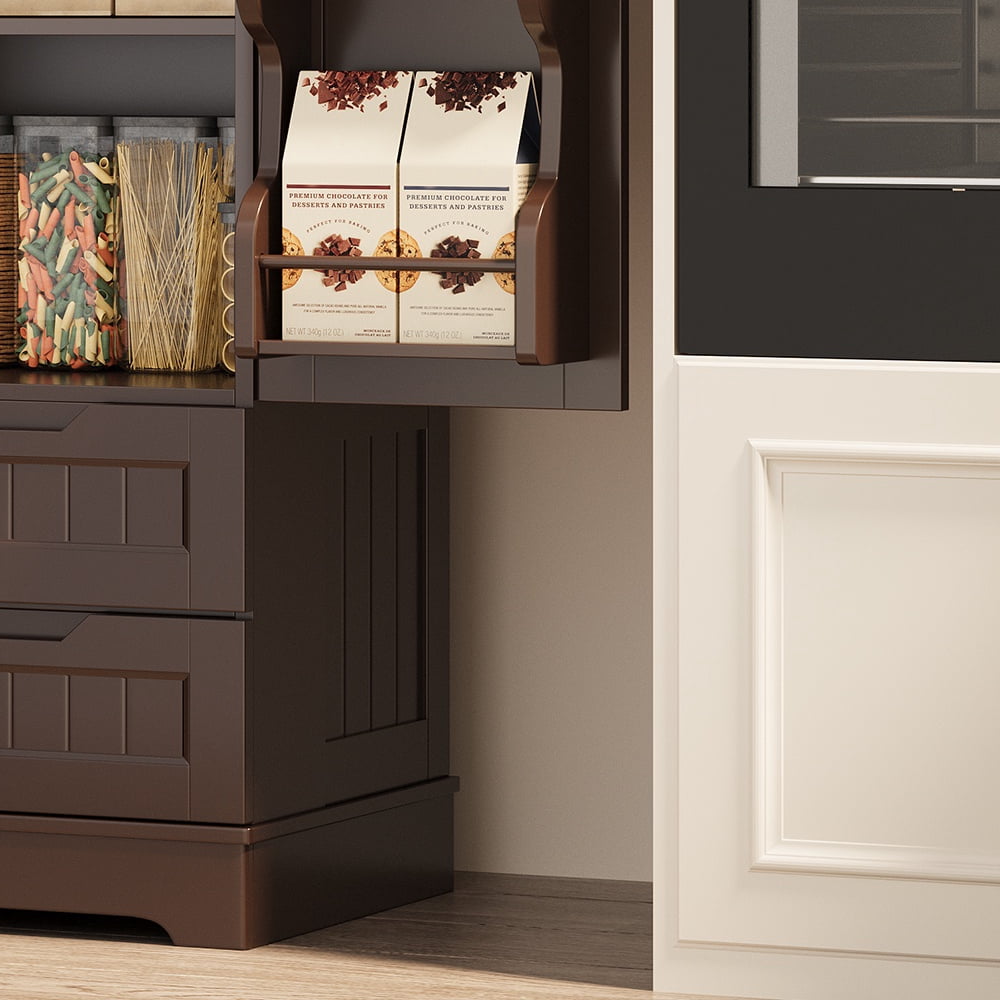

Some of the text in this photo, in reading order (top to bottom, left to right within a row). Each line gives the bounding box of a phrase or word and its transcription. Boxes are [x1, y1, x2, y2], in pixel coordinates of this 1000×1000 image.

[306, 219, 332, 233] PERFECT
[348, 220, 371, 234] BAKING
[423, 221, 450, 235] PERFECT
[466, 222, 490, 236] BAKING
[286, 327, 297, 336] NET
[297, 328, 306, 336] WT
[307, 328, 322, 337] 340g
[403, 329, 414, 338] NET
[415, 330, 424, 338] WT
[425, 330, 440, 339] 340g
